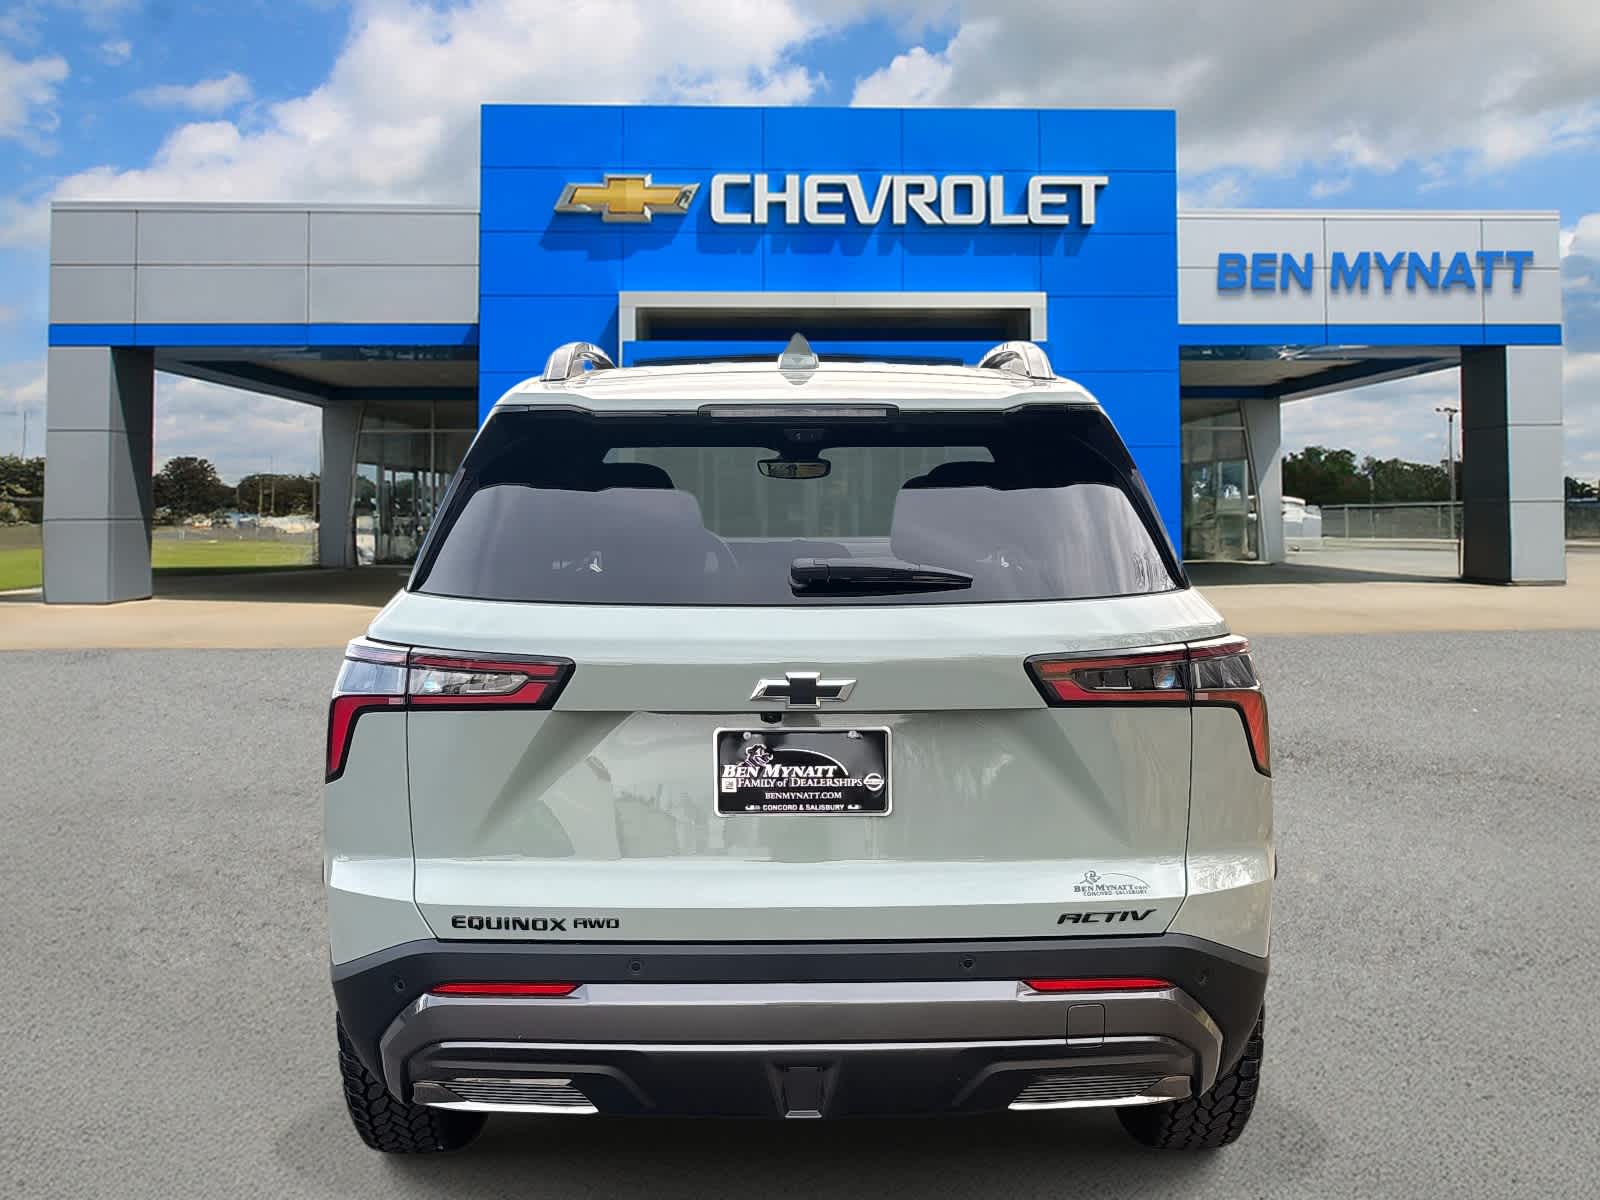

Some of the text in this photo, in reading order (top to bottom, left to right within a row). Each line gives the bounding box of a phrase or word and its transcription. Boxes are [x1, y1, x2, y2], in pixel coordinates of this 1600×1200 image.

[711, 174, 1108, 225] CHEVROLET
[1217, 250, 1534, 290] BEN MYNATT
[722, 764, 838, 778] BEN MYNATT
[737, 778, 776, 787] FAMILY
[777, 778, 788, 787] of
[791, 777, 863, 787] DEALERSHIPS
[451, 914, 620, 931] EQUINOX AWD
[1057, 909, 1157, 925] ACTIV
